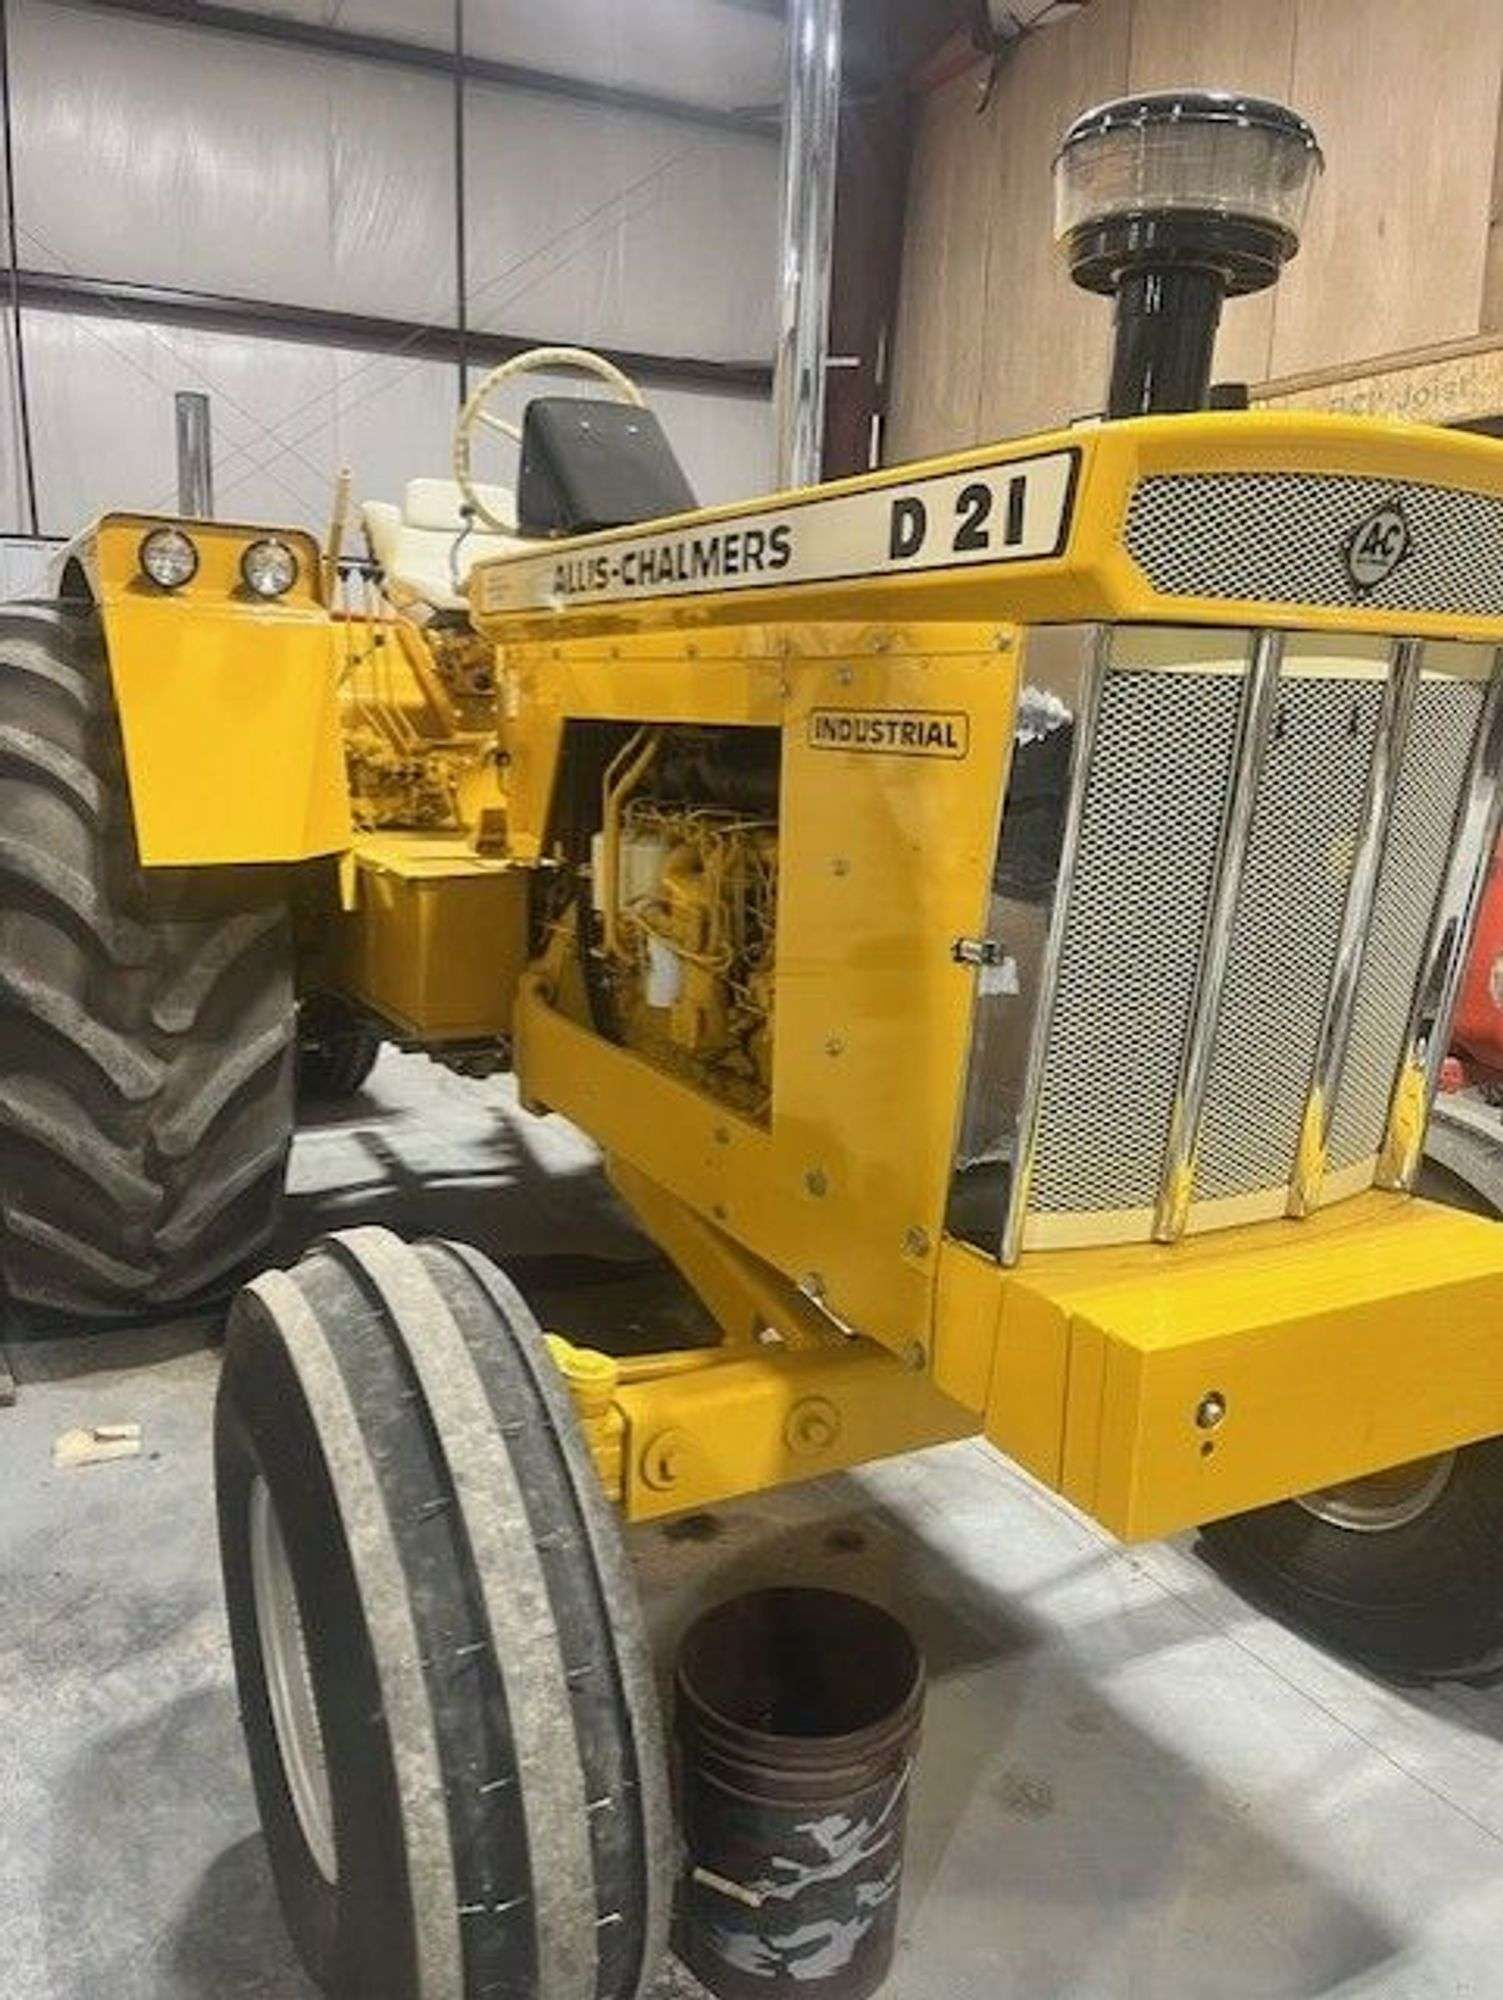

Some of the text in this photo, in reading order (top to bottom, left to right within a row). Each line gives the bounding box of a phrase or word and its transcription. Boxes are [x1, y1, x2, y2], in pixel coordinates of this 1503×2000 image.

[552, 475, 1027, 594] ALLIS-CHALMERS D 21
[814, 715, 958, 749] INDUSTRIAL
